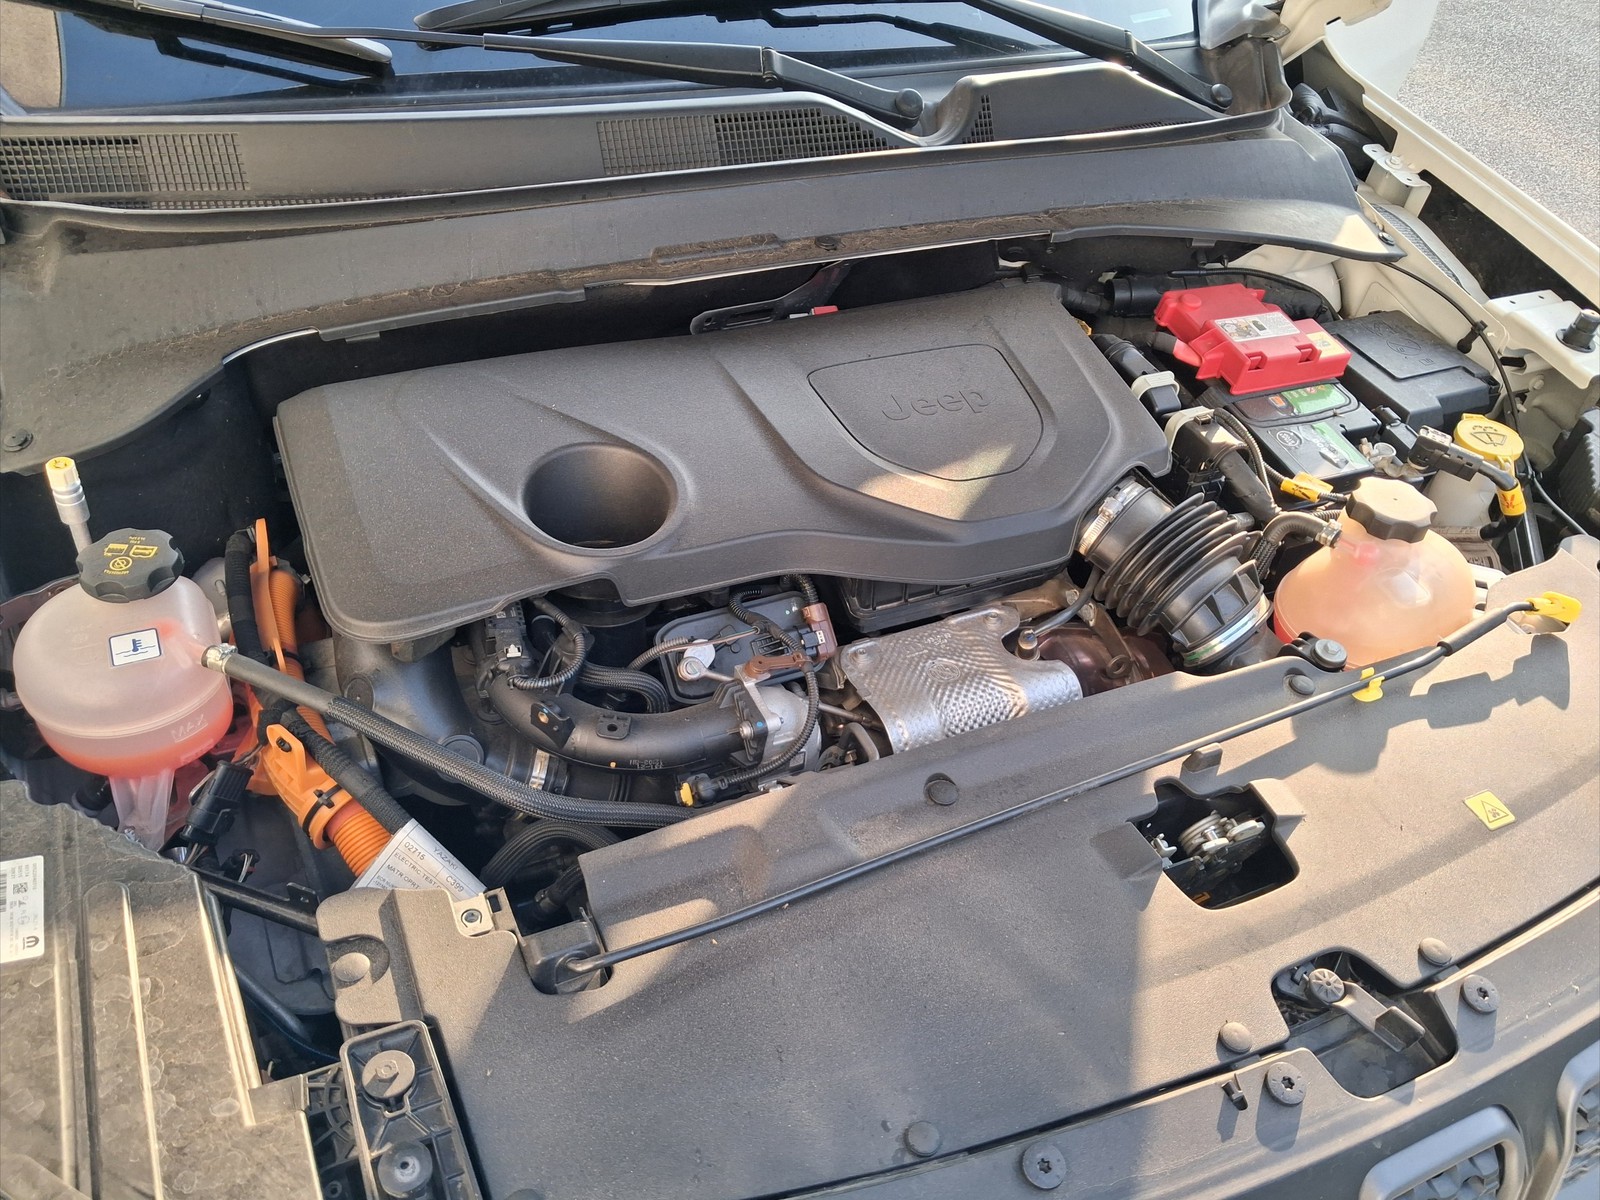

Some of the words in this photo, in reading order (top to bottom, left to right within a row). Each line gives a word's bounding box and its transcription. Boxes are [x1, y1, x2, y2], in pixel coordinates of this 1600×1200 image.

[880, 391, 991, 420] Jeep
[403, 841, 426, 861] 02715
[433, 847, 458, 871] YAZAKI
[386, 864, 403, 881] MATR
[394, 852, 421, 876] ELECTRIC
[422, 872, 437, 888] TEST
[445, 875, 464, 893] C399
